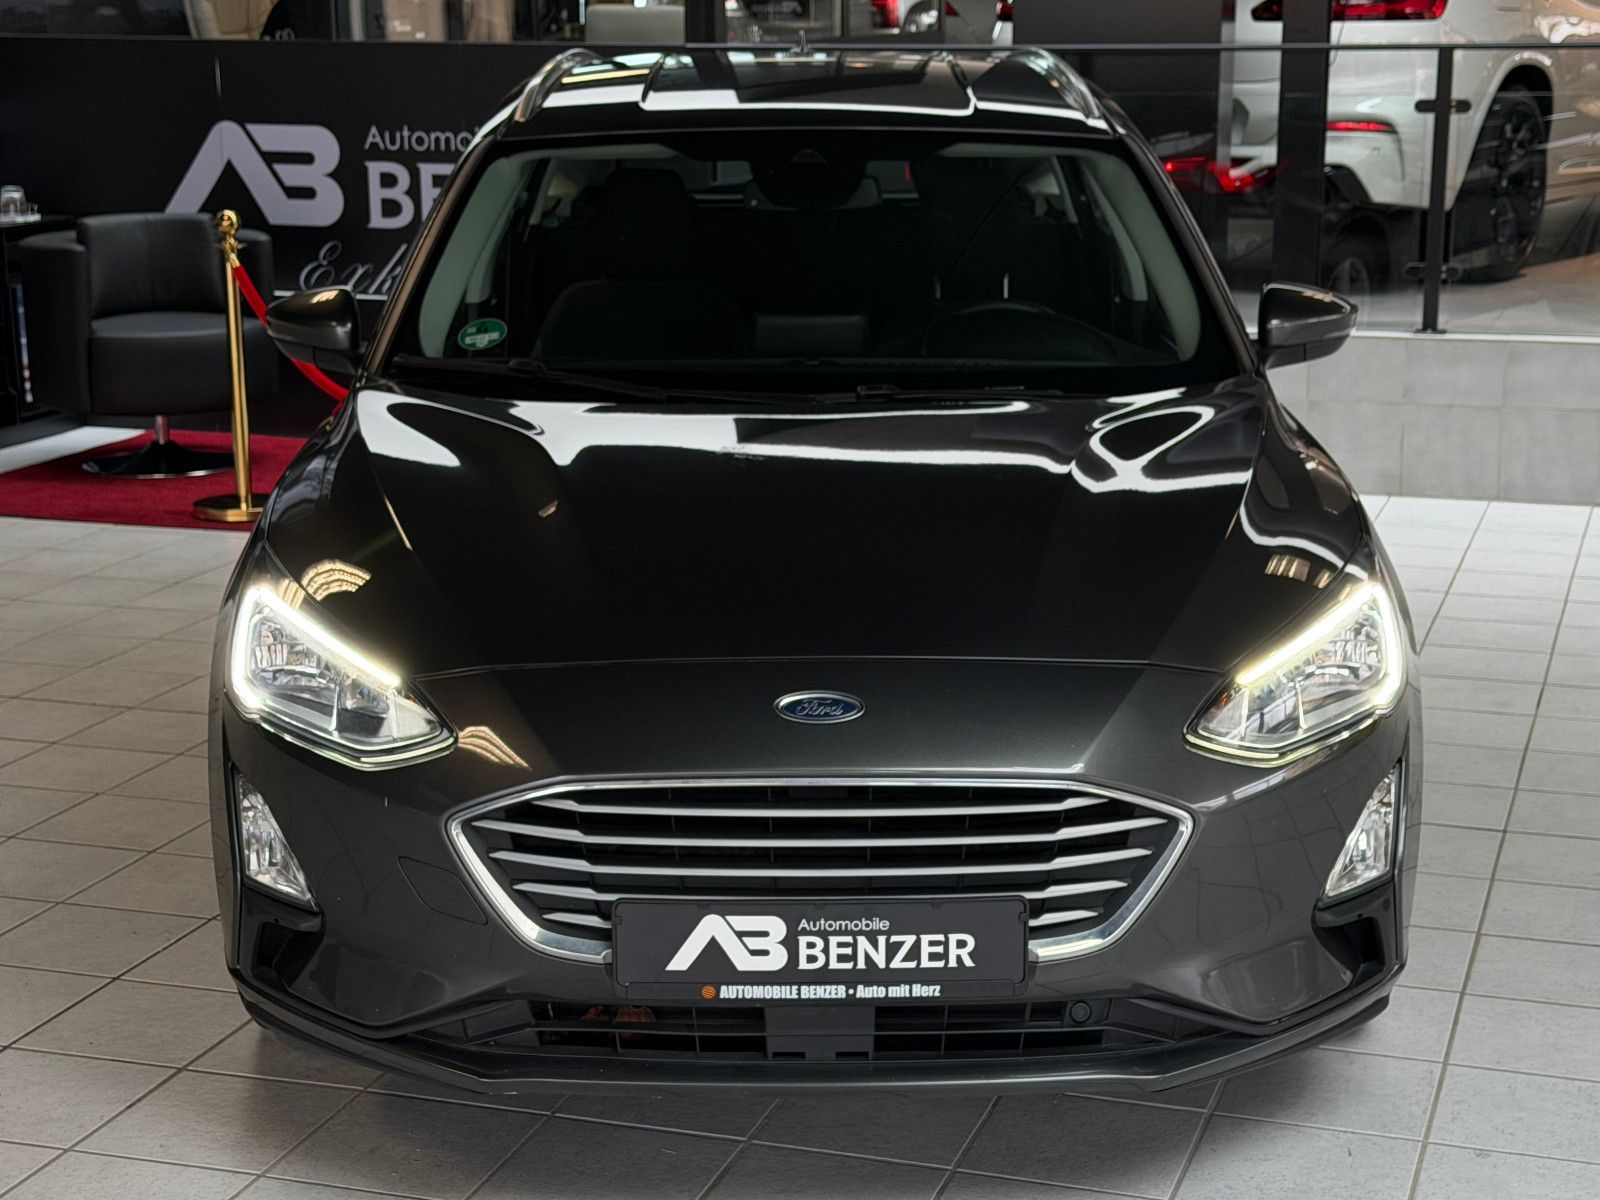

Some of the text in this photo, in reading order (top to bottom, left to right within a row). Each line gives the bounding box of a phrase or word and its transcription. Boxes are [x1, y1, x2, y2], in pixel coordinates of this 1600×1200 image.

[164, 119, 345, 227] AB
[796, 700, 844, 716] Ford
[798, 918, 890, 931] Automobile
[665, 914, 788, 971] AB
[797, 933, 976, 969] BENZER
[720, 984, 941, 998] AUTOMOBILE BENZER Auto mit Herz
